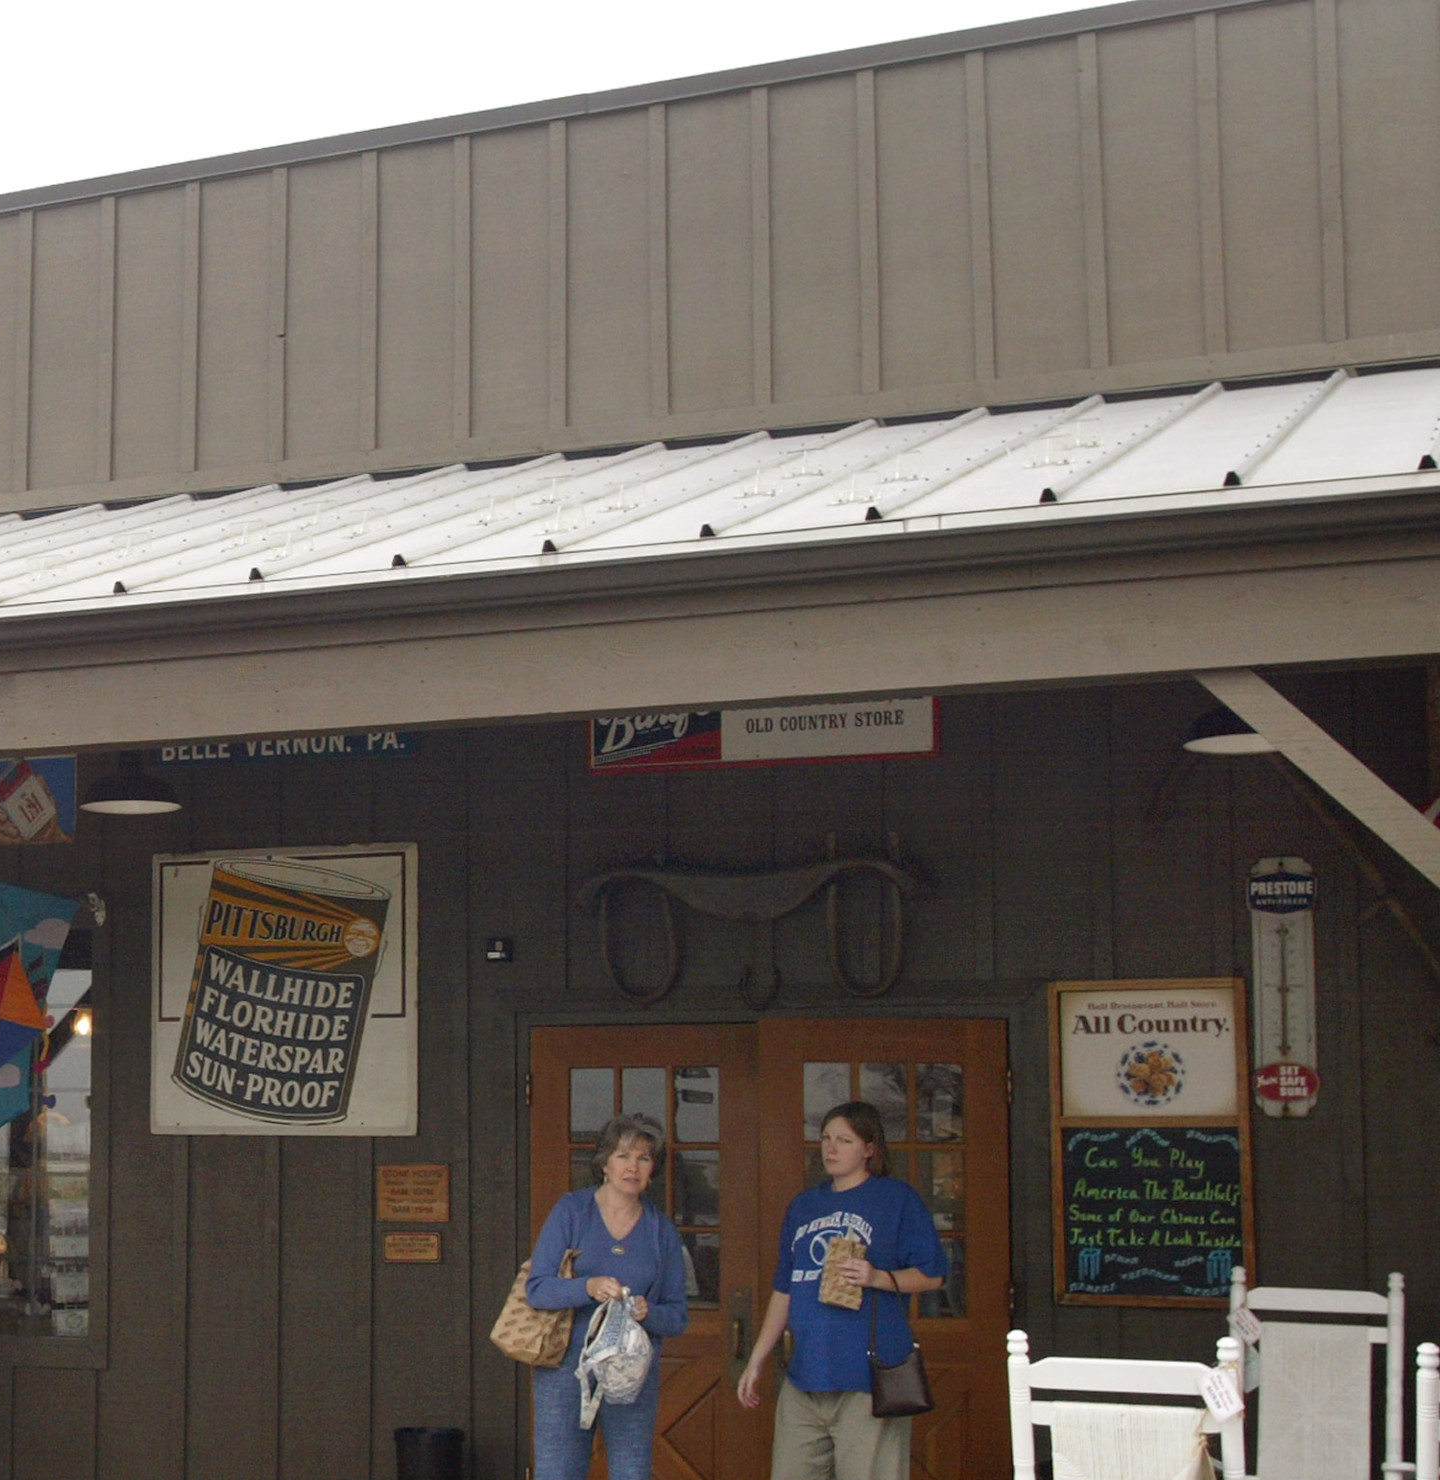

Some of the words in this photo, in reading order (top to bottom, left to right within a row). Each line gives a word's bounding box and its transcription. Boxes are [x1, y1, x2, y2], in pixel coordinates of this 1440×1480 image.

[746, 717, 773, 733] OLD
[779, 712, 847, 731] COUNTRY
[855, 709, 905, 727] STORE
[161, 743, 231, 761] BELLE
[367, 732, 405, 750] PA.
[1250, 880, 1314, 896] PRESTONE
[206, 900, 343, 943] PITTSBURGH
[210, 952, 354, 1009] WALLHIDE
[200, 987, 349, 1041] FLORHIDE
[1072, 1015, 1111, 1034] All
[1117, 1013, 1230, 1037] Country.
[195, 1017, 345, 1074] WATERSPAR
[186, 1051, 339, 1108] SUN-PROOF
[1084, 1147, 1118, 1168] Can
[1131, 1147, 1160, 1167] You
[1169, 1148, 1205, 1179] Play
[1072, 1177, 1140, 1199] America
[1143, 1179, 1168, 1200] The
[1069, 1204, 1103, 1222] Some
[1108, 1208, 1124, 1222] of
[1129, 1209, 1155, 1224] Our
[1161, 1208, 1205, 1225] Chimes
[1210, 1211, 1236, 1224] Can
[1069, 1227, 1104, 1246] Just
[1107, 1229, 1146, 1246] Take
[1149, 1229, 1160, 1246] A
[1164, 1230, 1193, 1246] Look
